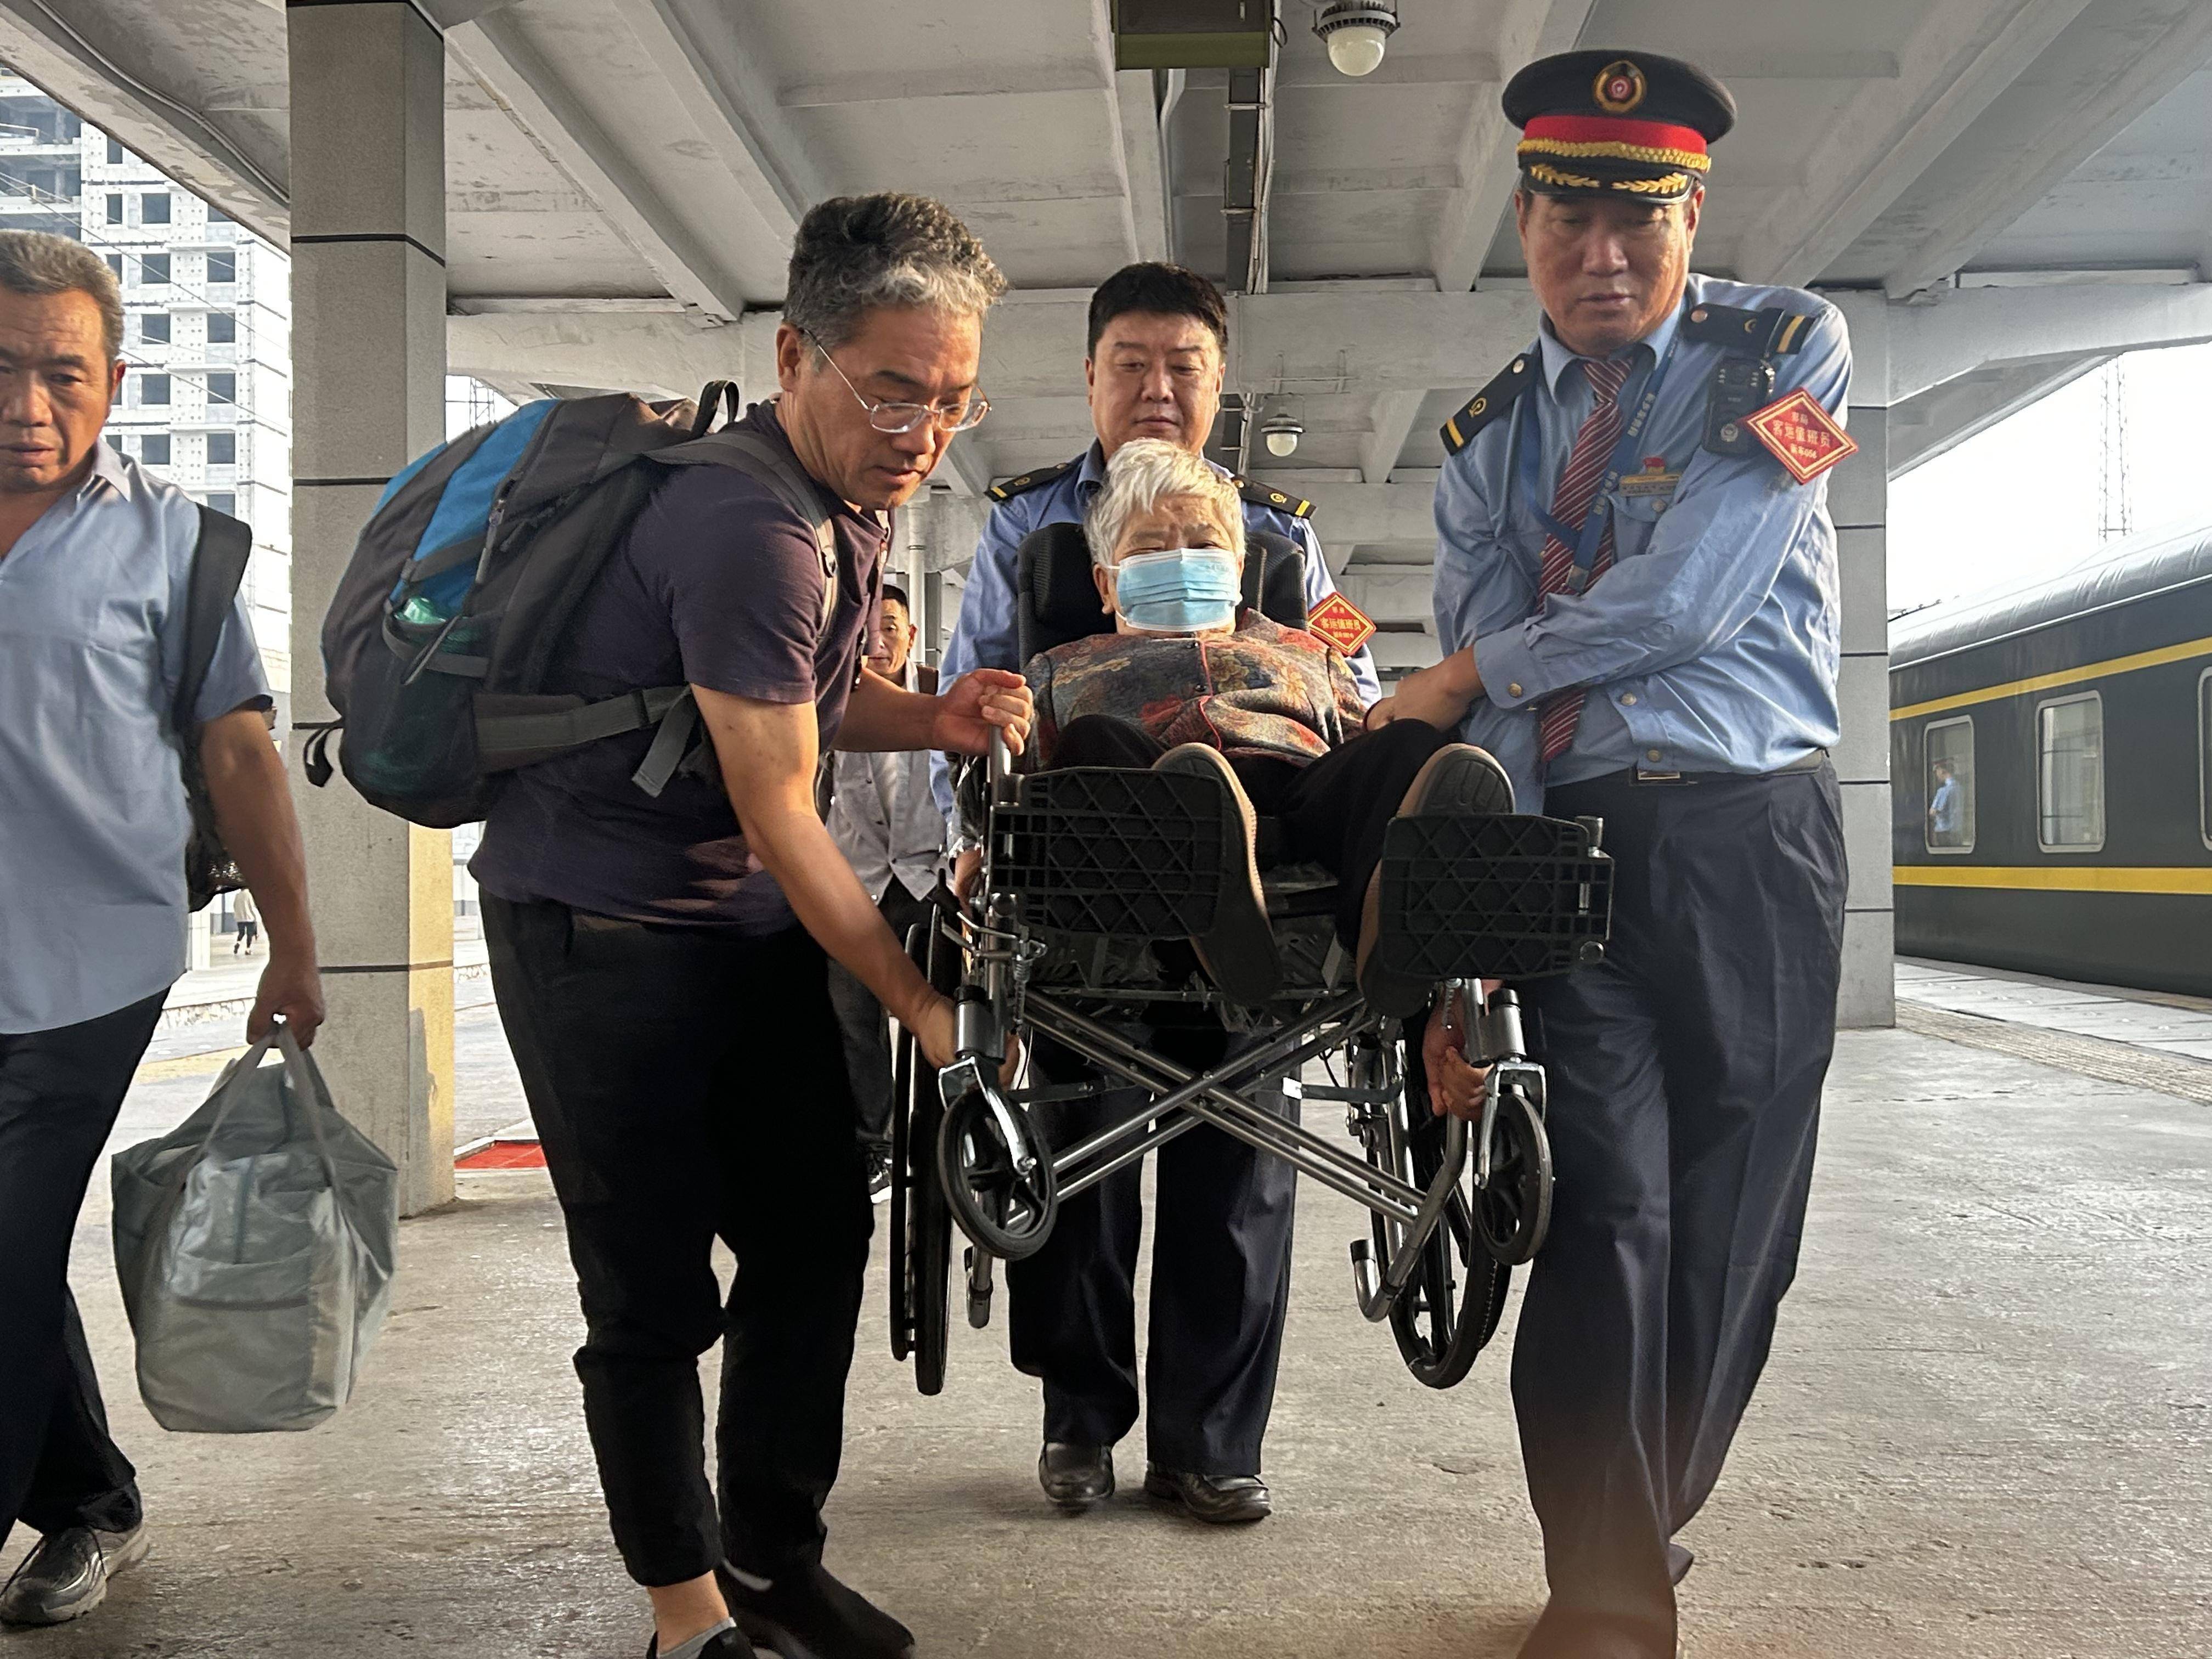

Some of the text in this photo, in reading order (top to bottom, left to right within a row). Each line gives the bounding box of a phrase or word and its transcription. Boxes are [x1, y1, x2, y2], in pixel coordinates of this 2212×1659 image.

[1773, 420, 1830, 449] 客运值班员
